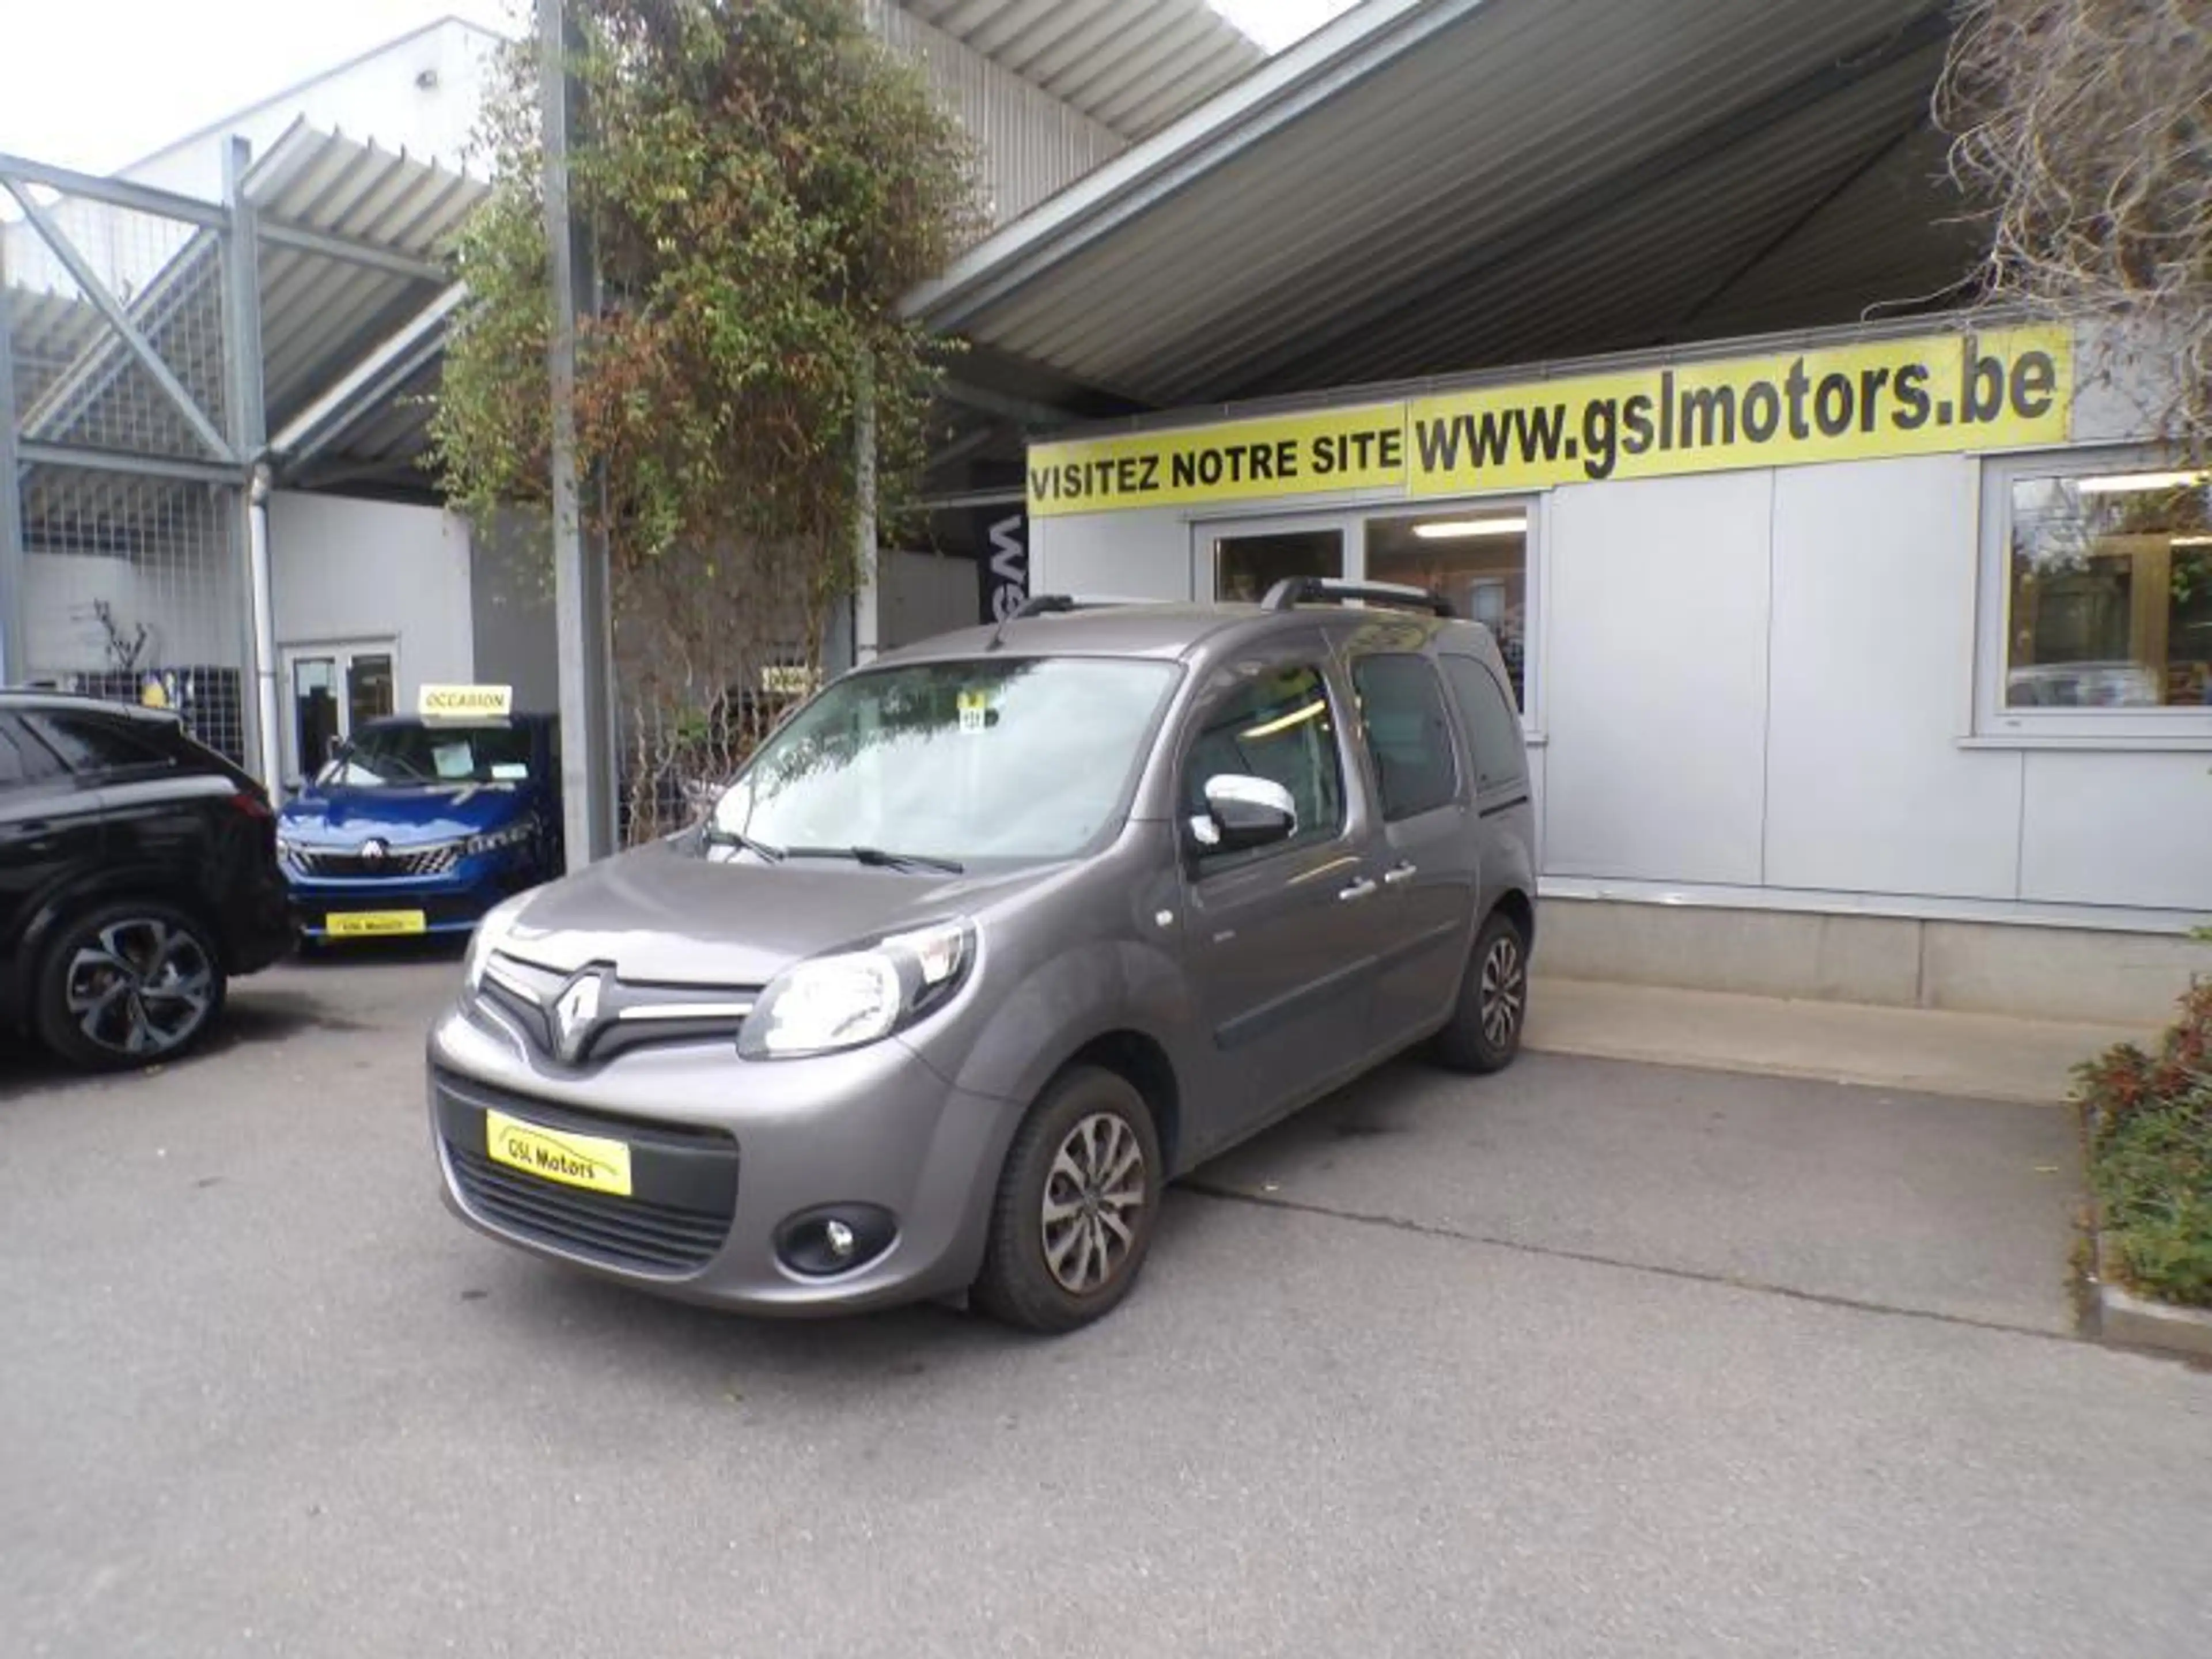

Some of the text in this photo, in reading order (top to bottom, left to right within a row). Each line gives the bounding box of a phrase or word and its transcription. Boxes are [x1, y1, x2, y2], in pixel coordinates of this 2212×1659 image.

[1030, 335, 2056, 501] VISITEZ NOTRE SITE www.gslmotors.be
[507, 1138, 596, 1179] GSL Motors
